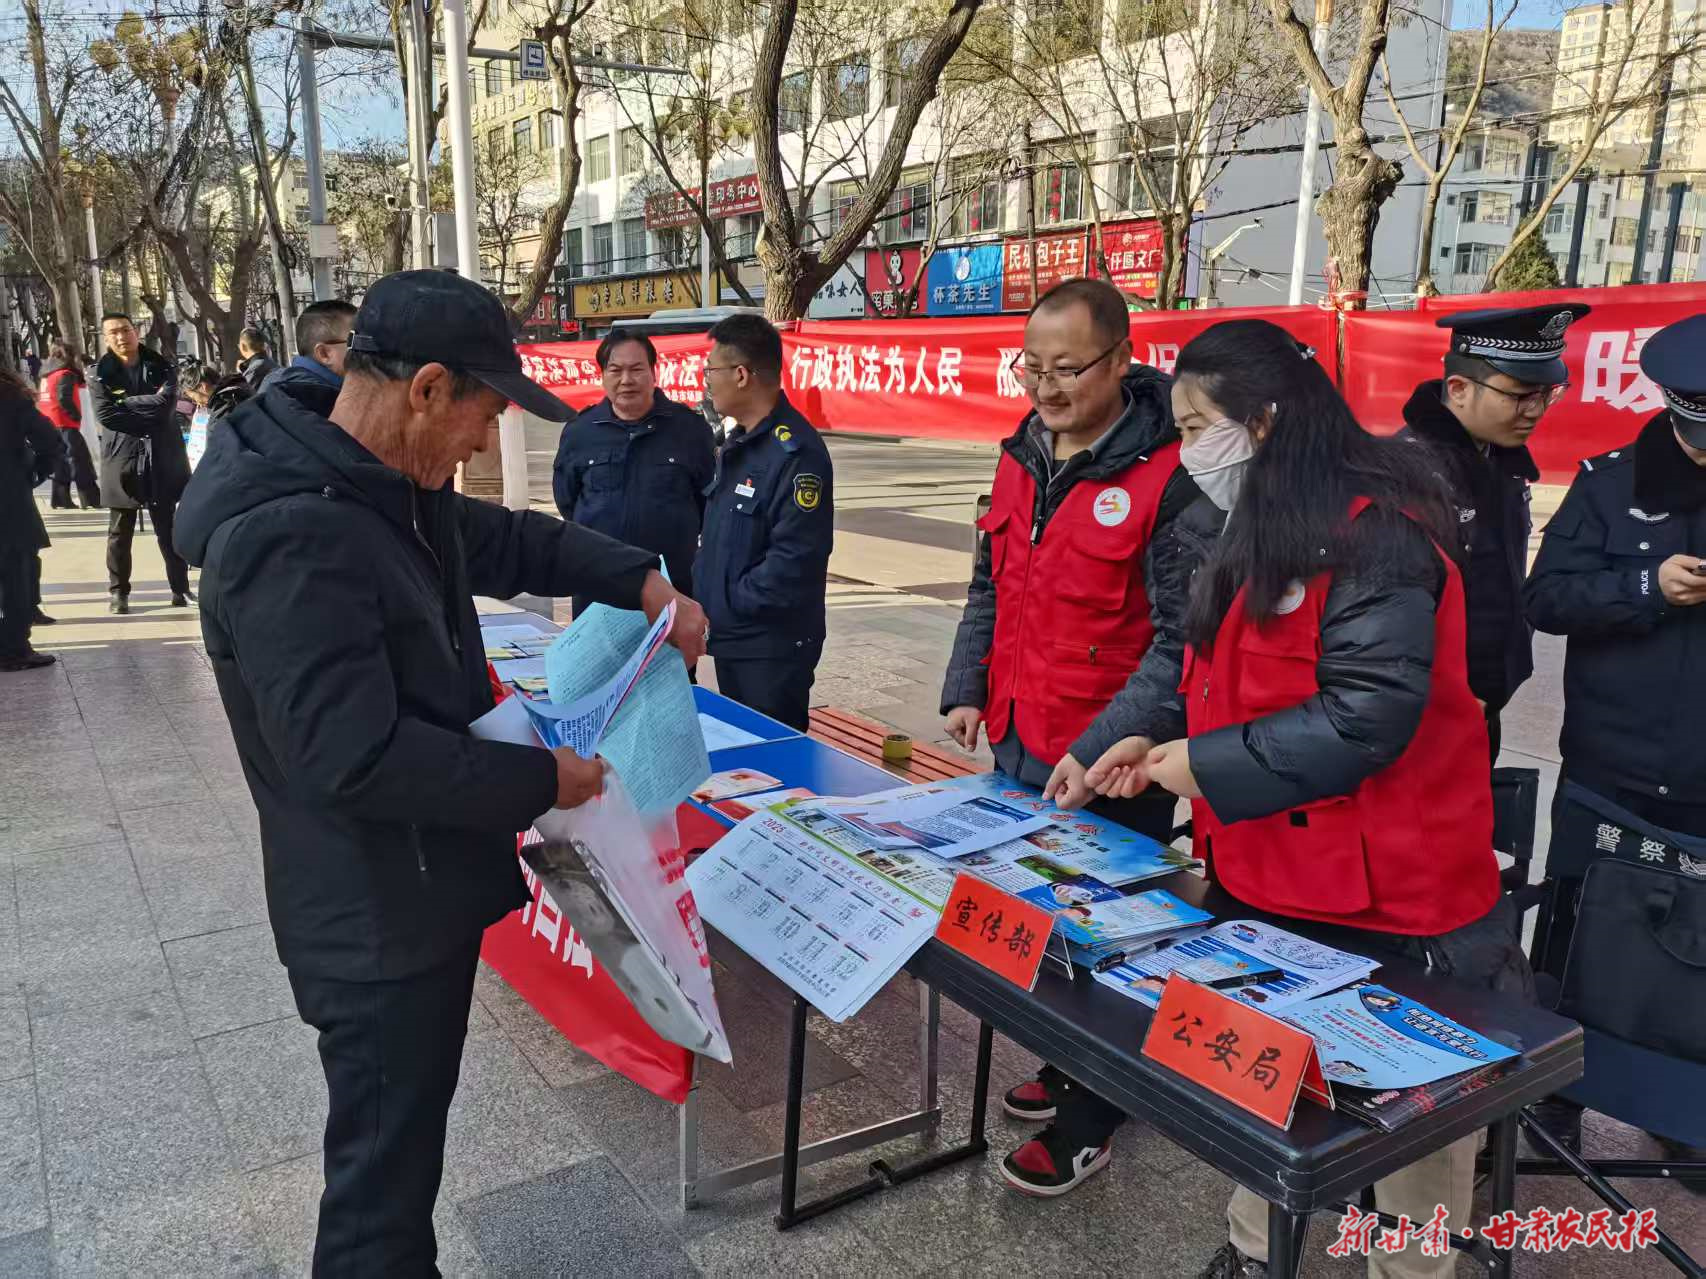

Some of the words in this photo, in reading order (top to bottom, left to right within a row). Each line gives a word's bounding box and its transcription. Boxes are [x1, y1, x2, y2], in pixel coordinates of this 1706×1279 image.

[933, 285, 991, 304] 杯茶先生
[790, 345, 963, 396] 行政执法为人民
[1641, 569, 1649, 595] POLICE
[761, 818, 785, 833] 2025
[952, 896, 1035, 960] 宣传部
[1171, 1010, 1281, 1092] 公安局
